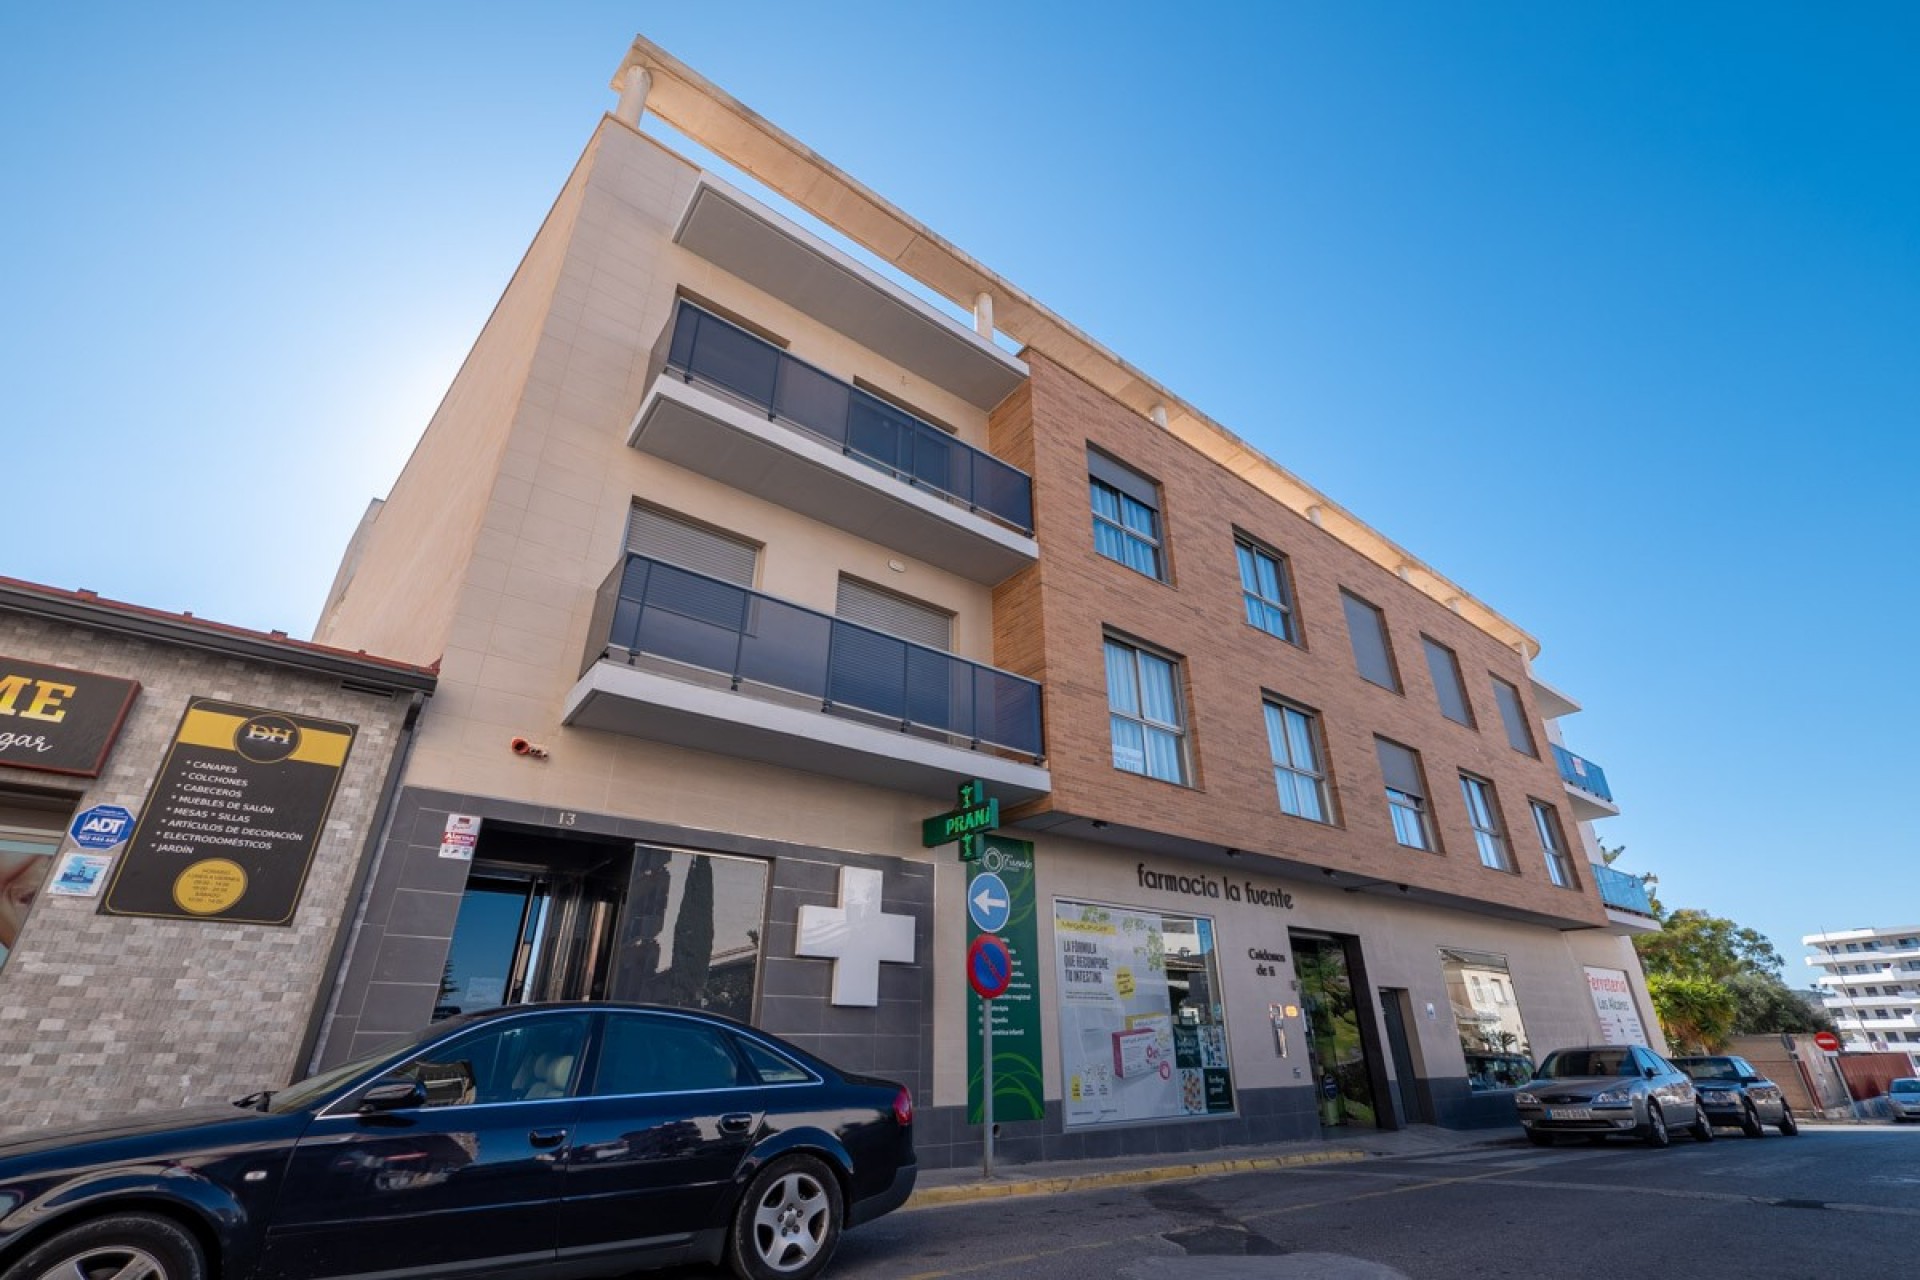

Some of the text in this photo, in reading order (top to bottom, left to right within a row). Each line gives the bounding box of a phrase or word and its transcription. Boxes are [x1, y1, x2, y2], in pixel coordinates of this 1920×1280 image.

[246, 724, 294, 745] DH
[193, 761, 238, 774] CANAPES
[188, 772, 249, 787] COLCHONES
[183, 783, 242, 798] CABECEROS
[179, 795, 275, 814] MUEBLES DE SALÓN
[173, 807, 251, 823] MESAS SILLAS
[559, 812, 577, 826] 13
[83, 817, 125, 834] ADT
[168, 818, 303, 841] ARTÍCULOS DE DECORACIÓN
[162, 831, 273, 850] ELECTRODOMÉSTICOS
[156, 844, 195, 854] JARDÍN
[1137, 863, 1293, 909] farmacia la fuente
[1256, 963, 1267, 976] de
